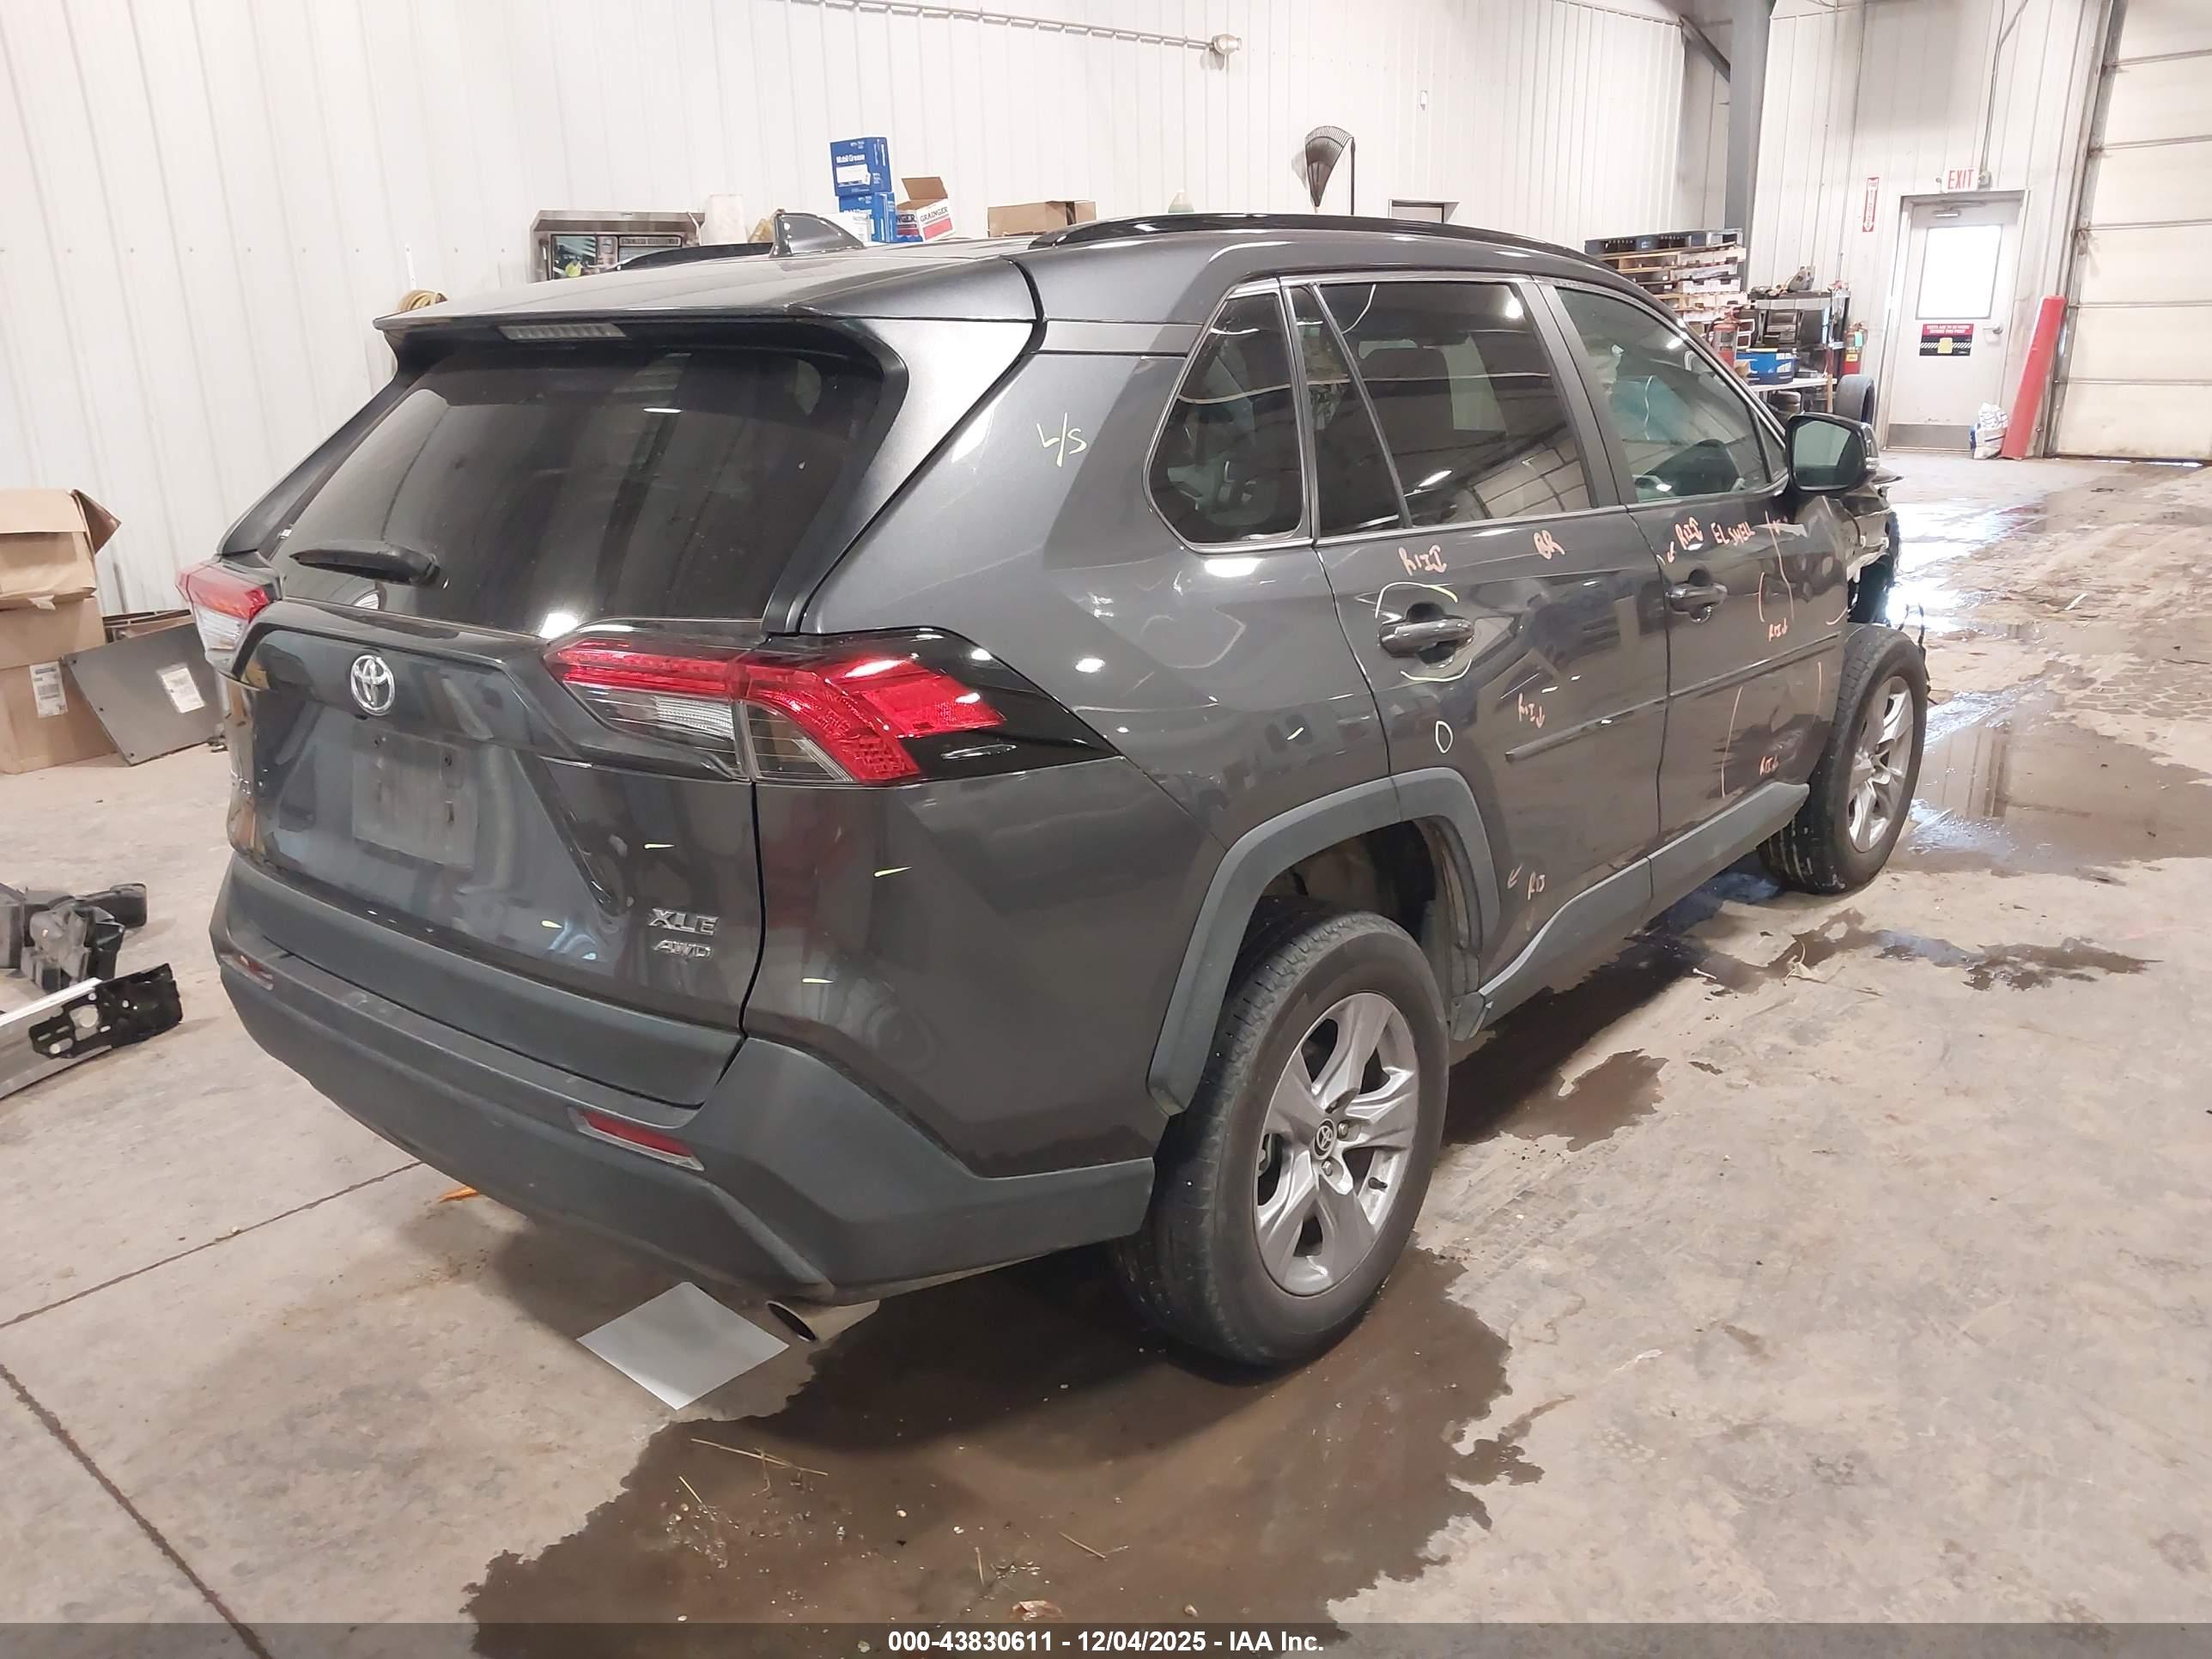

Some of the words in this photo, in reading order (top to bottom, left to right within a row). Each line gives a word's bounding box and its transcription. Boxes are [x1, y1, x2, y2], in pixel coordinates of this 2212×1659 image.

[1948, 169, 1974, 189] EXIT
[920, 206, 949, 222] GRAINGER
[647, 908, 720, 936] XLE
[652, 939, 714, 958] AWD
